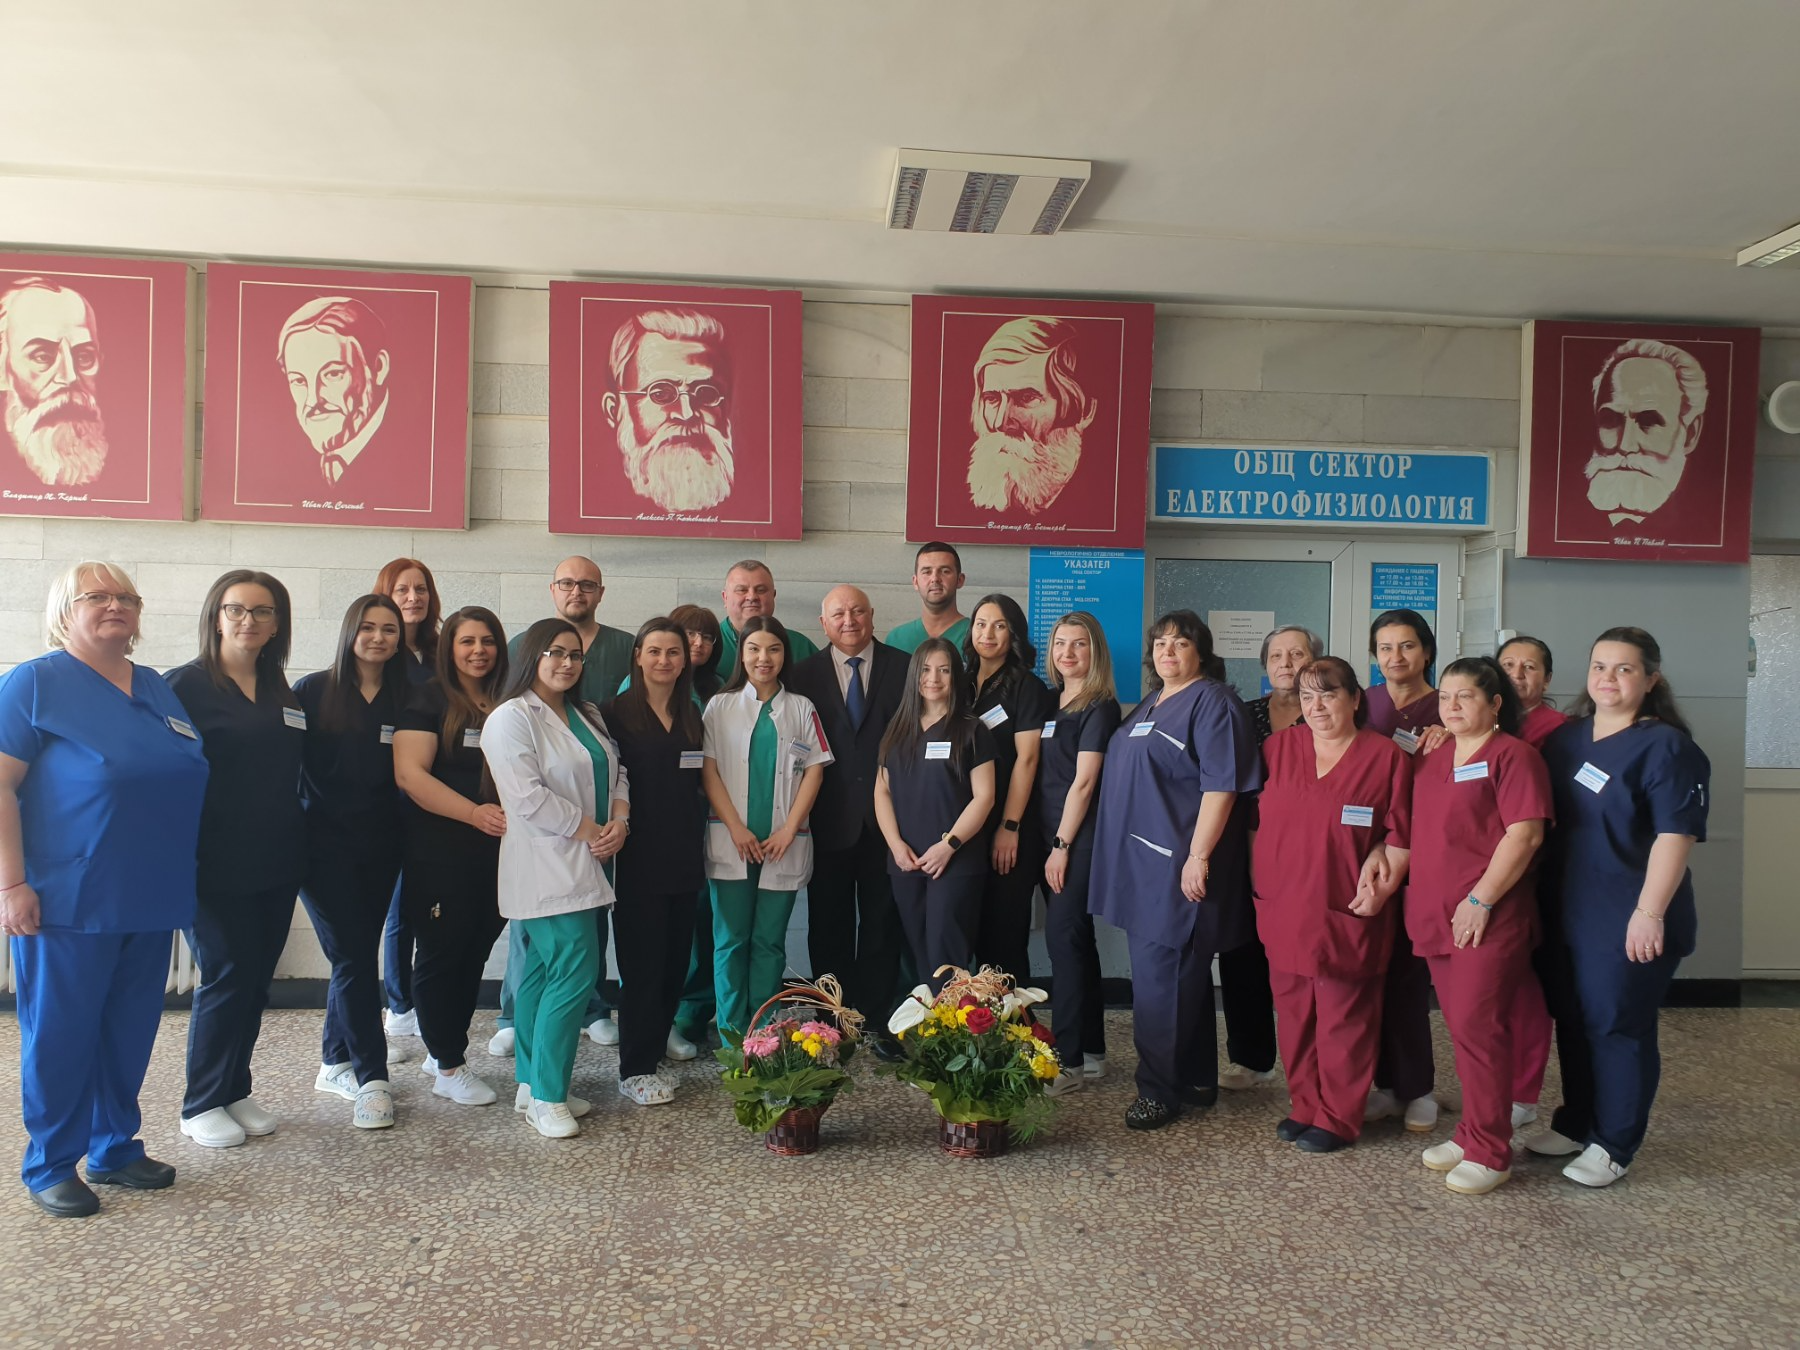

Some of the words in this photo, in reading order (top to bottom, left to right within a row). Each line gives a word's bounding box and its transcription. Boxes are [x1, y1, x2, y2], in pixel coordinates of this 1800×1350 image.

[1234, 450, 1296, 481] ОБЩ
[1309, 452, 1412, 478] СЕКТОР
[1167, 489, 1474, 520] ЕЛЕКТРОФИЗИОЛОГИЯ
[1064, 560, 1110, 568] УКАЗАТЕЛ
